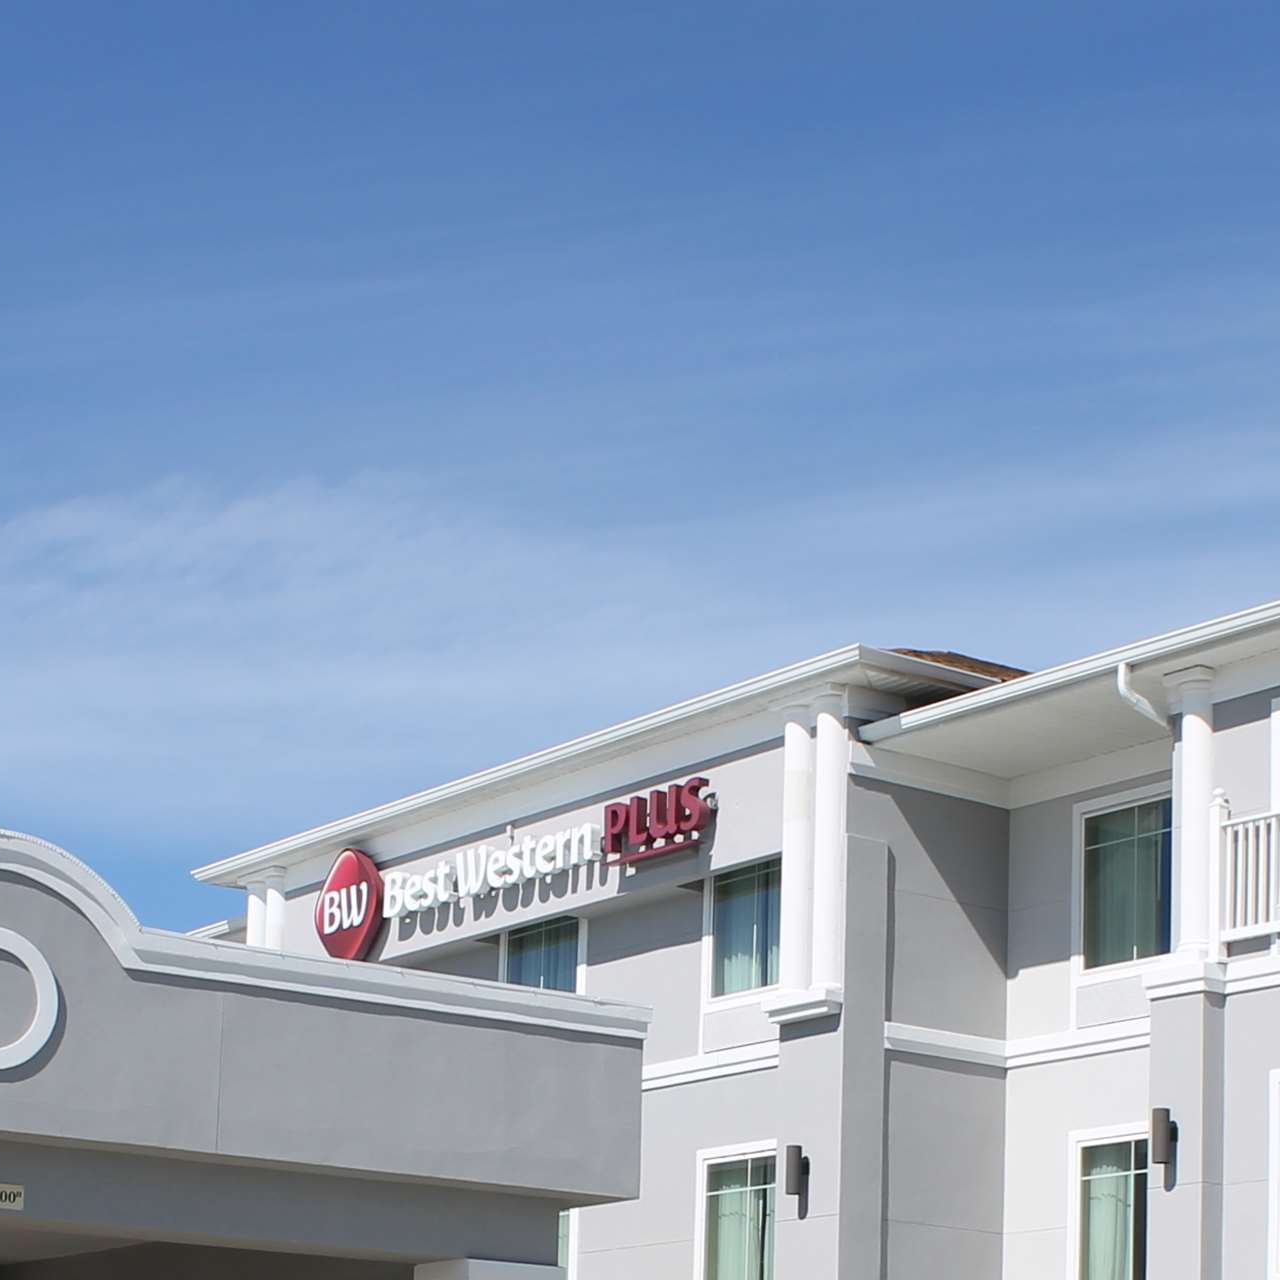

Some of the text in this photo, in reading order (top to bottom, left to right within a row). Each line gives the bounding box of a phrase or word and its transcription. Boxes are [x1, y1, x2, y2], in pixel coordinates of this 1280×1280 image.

[382, 776, 710, 918] Best Western PLUS
[323, 880, 369, 935] BW
